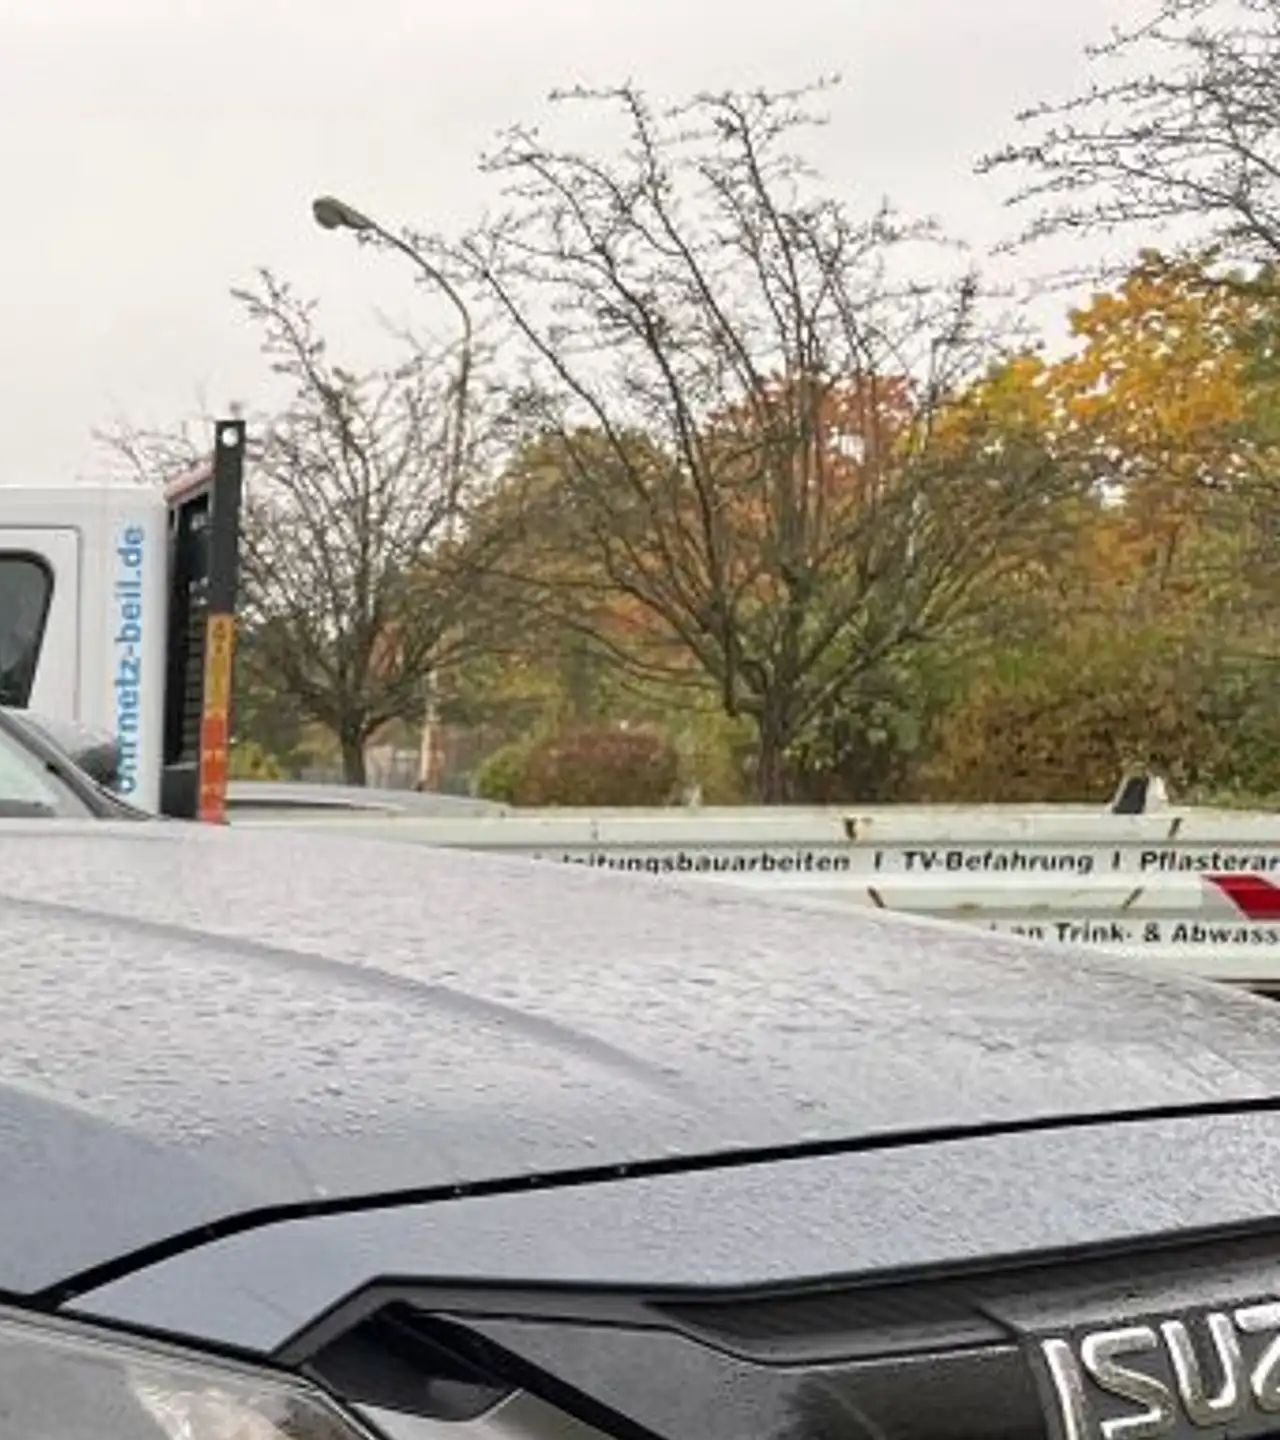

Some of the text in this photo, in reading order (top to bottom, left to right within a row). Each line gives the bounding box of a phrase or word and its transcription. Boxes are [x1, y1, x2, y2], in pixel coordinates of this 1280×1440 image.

[901, 850, 1095, 875] TV-Befahrung
[1053, 921, 1133, 943] Trink-
[1142, 922, 1161, 944] &
[1171, 922, 1280, 944] Abwass
